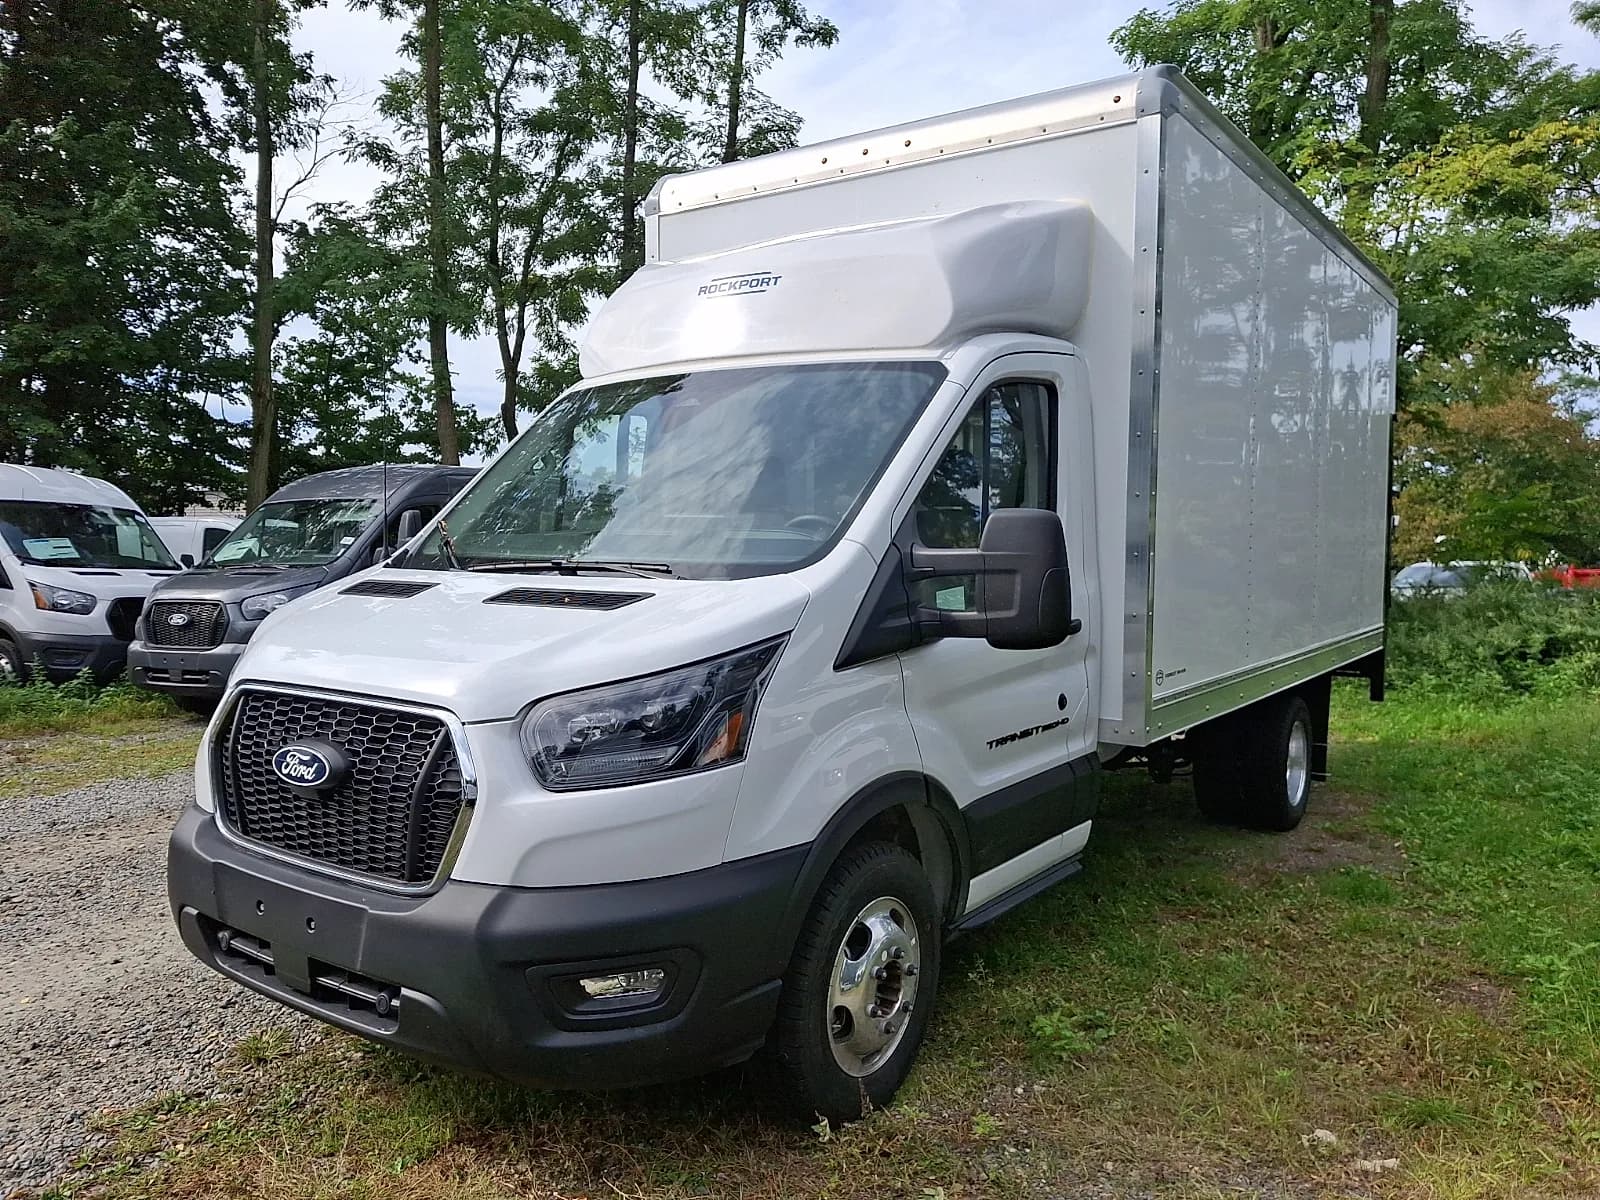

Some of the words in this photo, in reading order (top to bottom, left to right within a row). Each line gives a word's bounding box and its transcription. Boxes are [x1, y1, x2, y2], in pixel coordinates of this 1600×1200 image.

[698, 276, 782, 295] ROCKPORT
[986, 725, 1042, 750] TRANSIT
[281, 751, 317, 779] Ford
